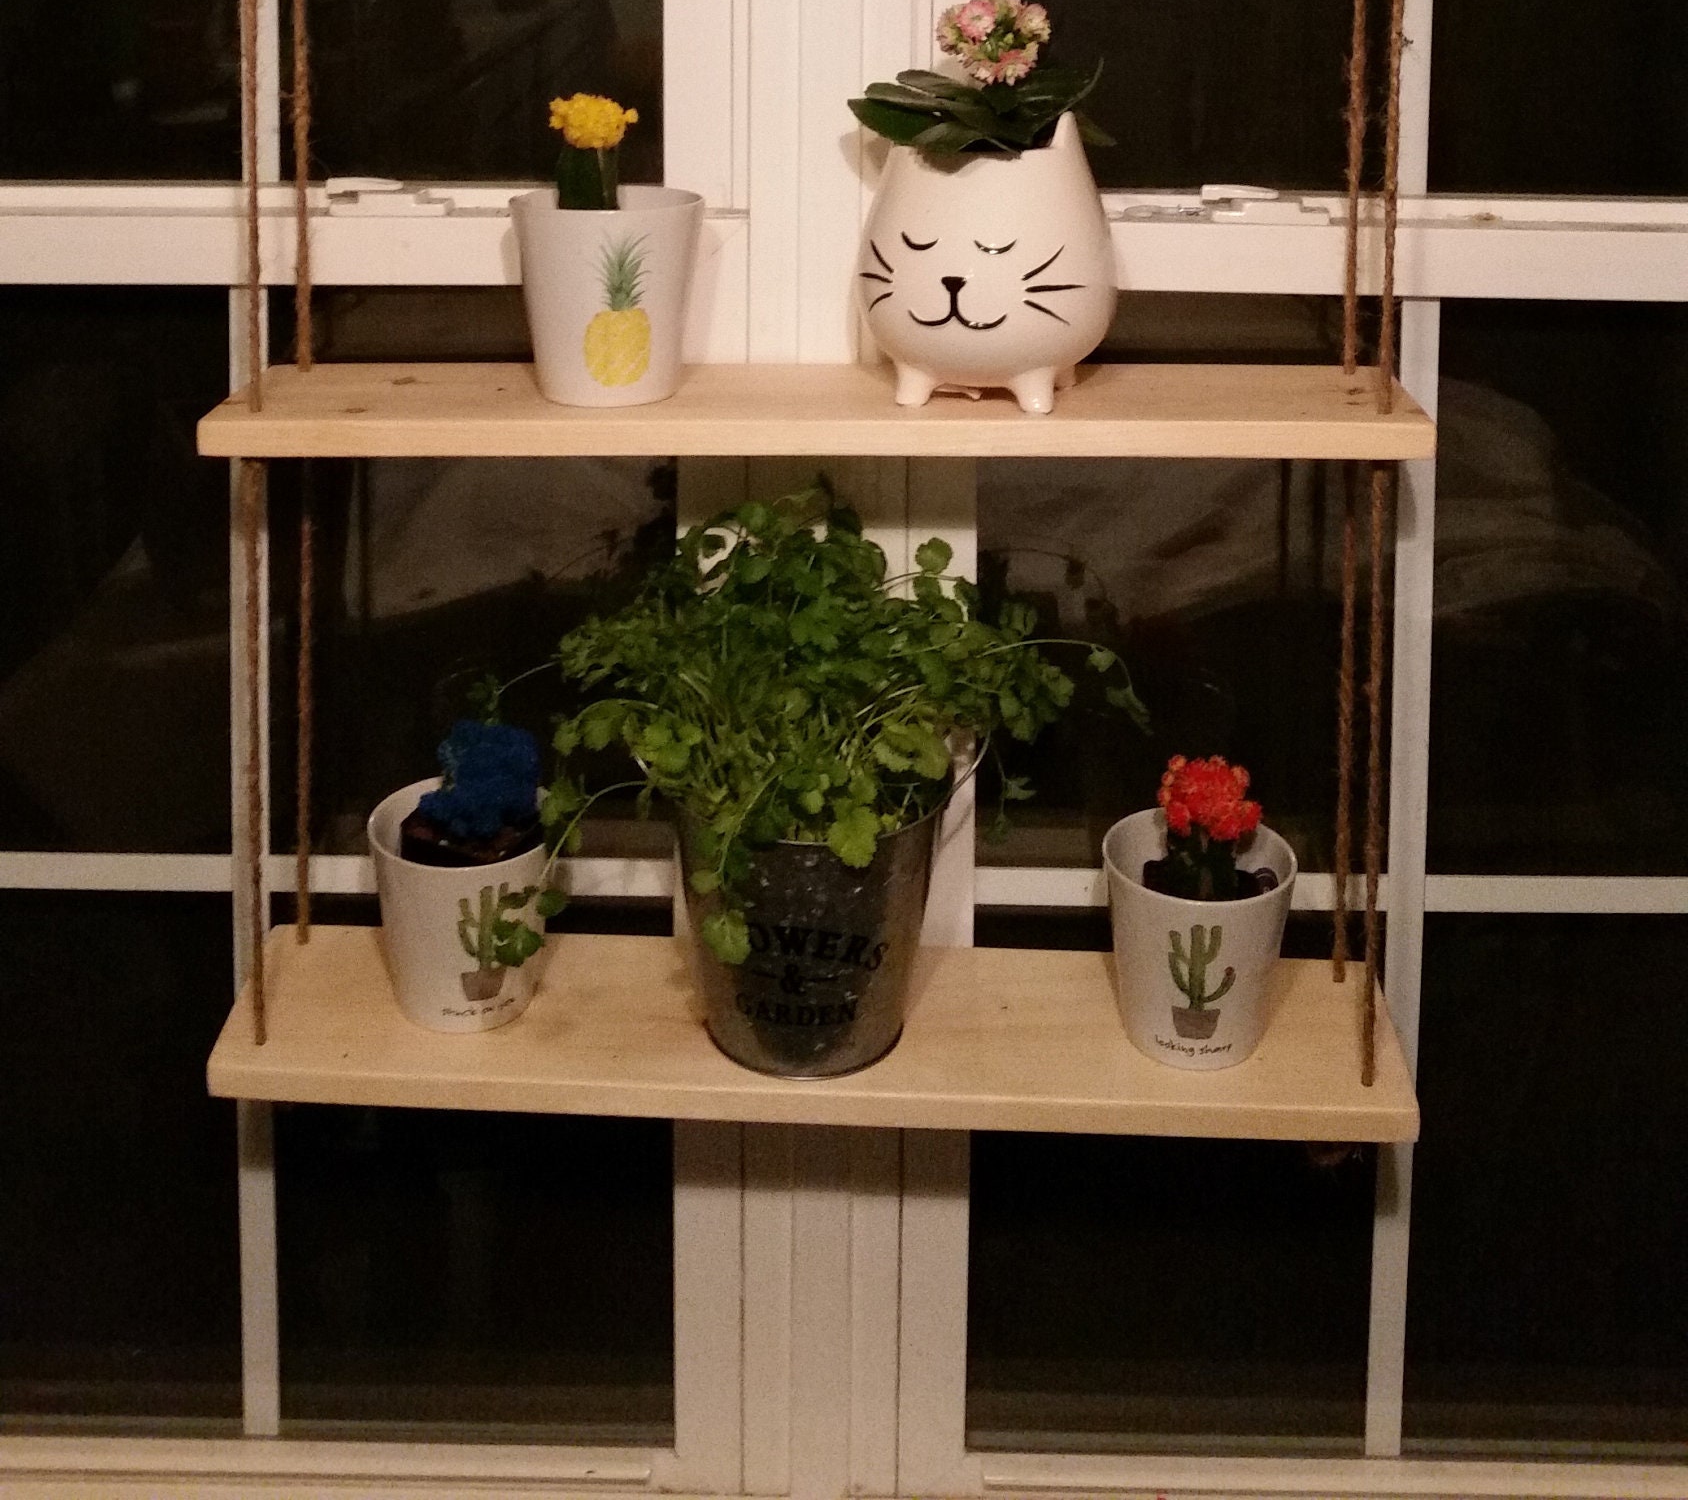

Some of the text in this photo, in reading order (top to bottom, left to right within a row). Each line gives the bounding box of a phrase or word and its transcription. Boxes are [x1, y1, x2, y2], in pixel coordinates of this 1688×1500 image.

[747, 922, 890, 971] OWERS
[779, 963, 807, 994] &
[735, 992, 859, 1026] GARDEN
